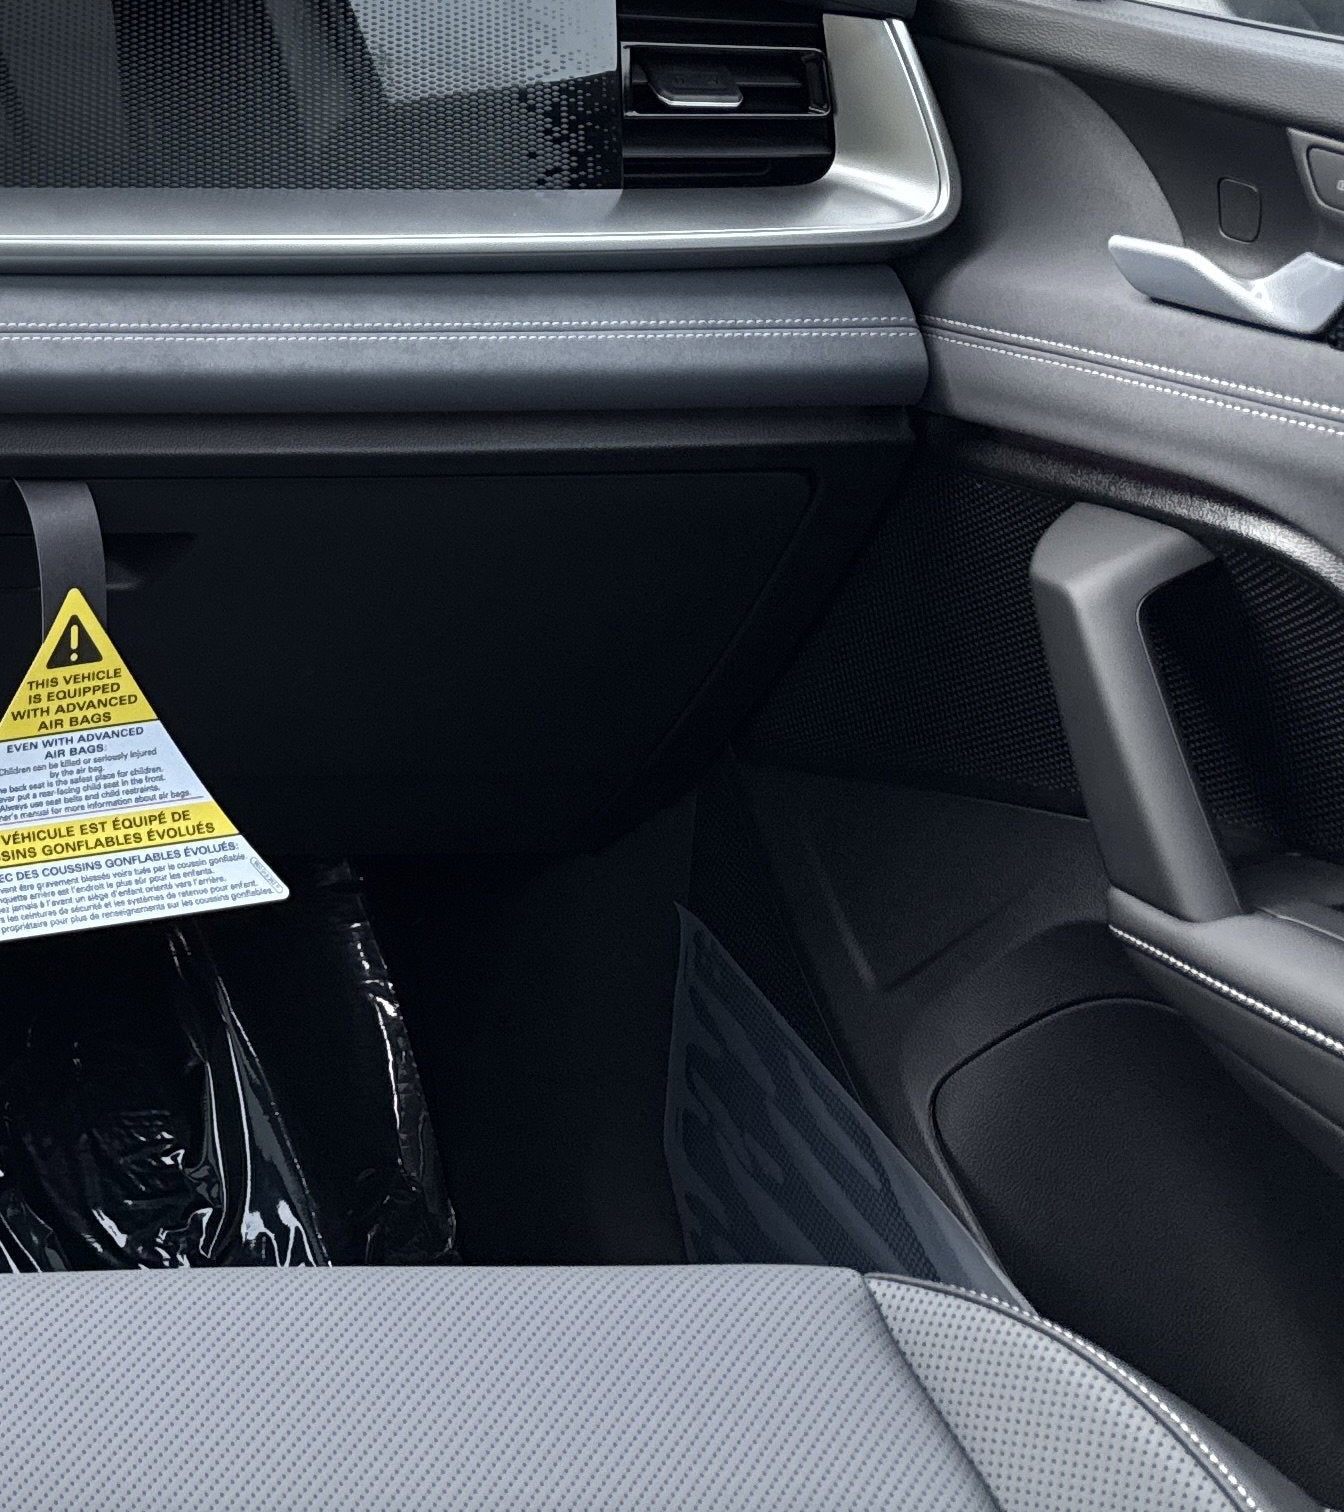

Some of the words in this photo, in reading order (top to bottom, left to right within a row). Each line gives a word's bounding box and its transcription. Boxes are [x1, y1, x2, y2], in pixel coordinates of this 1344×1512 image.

[27, 677, 58, 691] THIS
[63, 668, 122, 686] VEHICLE
[29, 693, 42, 705] IS
[47, 682, 121, 702] EQUIPPED
[11, 706, 50, 721] WITH
[54, 694, 138, 715] ADVANCED
[38, 719, 64, 732] AIR
[70, 712, 112, 727] BAGS
[7, 742, 38, 753] EVEN
[42, 736, 74, 748] WITH
[77, 726, 144, 743] ADVANCED
[0, 765, 31, 777] Children
[33, 764, 47, 772] can
[48, 762, 58, 770] be
[60, 758, 81, 768] killed
[93, 752, 128, 763] seriously
[130, 748, 157, 759] injured
[44, 749, 65, 760] AIR
[50, 770, 60, 779] by
[61, 768, 75, 777] the
[76, 767, 86, 775] air
[88, 765, 105, 775] bag.
[0, 825, 75, 847] VÉHICULE
[80, 821, 107, 835] EST
[112, 811, 167, 831] ÉQUIPÉ
[172, 810, 192, 822] DE
[41, 830, 142, 857] GONFLABLES
[147, 821, 216, 842] ÉVOLUÉS
[16, 870, 39, 881] DES
[41, 860, 103, 877] COUSSINS
[105, 850, 181, 869] GONFLABLES
[184, 841, 239, 858] ÉVOLUÉS:
